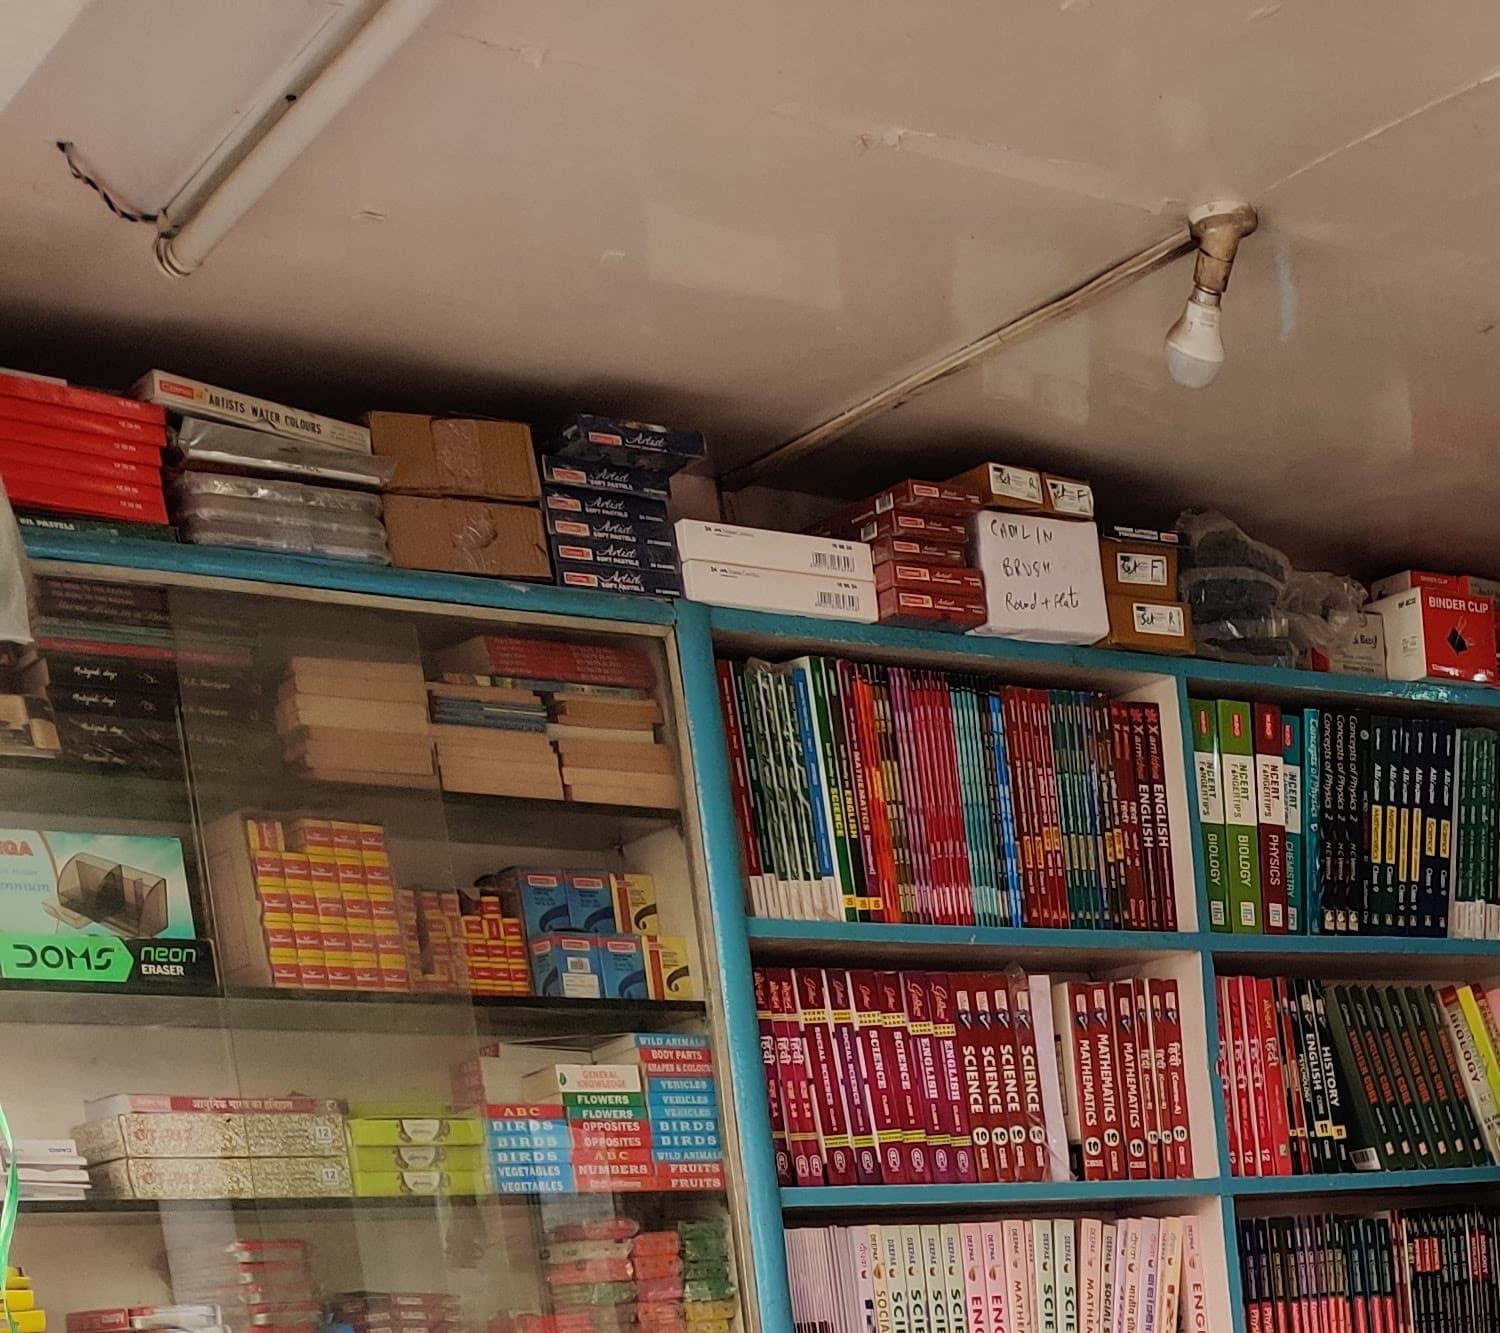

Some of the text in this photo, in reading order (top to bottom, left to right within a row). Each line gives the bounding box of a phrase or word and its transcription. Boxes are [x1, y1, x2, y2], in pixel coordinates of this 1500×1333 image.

[209, 394, 321, 435] ARTISTS WATER COLOURS
[625, 432, 665, 447] Artist
[1428, 596, 1489, 615] BINDER CLIP
[1206, 761, 1217, 799] NCERT
[1238, 761, 1249, 800] NCERT
[1269, 763, 1279, 801] NCERT
[1138, 784, 1153, 848] ENGLISH
[1153, 783, 1169, 847] ENGLISH
[1208, 834, 1222, 887] BIOLOGY
[1238, 835, 1252, 888] BIOLOGY
[1269, 834, 1281, 886] PHYSICS
[1285, 840, 1295, 898] CHEMISTRY
[12, 944, 115, 971] DOMS
[140, 947, 198, 964] neon
[141, 965, 184, 976] ERASER
[639, 1037, 706, 1047] WILD ANIMALS
[1451, 1013, 1480, 1083] BIOLOGY
[652, 1050, 702, 1061] BODY PARTS
[1306, 1033, 1321, 1090] ENGLISH
[583, 1070, 619, 1079] GENERAL
[963, 1046, 983, 1114] SCIENCE
[982, 1046, 1002, 1114] SCIENCE
[1098, 1034, 1116, 1123] MATHEMATICS
[1322, 1045, 1340, 1107] HISTORY
[577, 1079, 626, 1088] KNOWLEDGE
[661, 1080, 706, 1089] VEHICLES
[1080, 1040, 1097, 1126] MATHEMATICS
[1123, 1043, 1140, 1128] MATHEMATICS
[577, 1095, 629, 1104] FLOWERS
[662, 1095, 709, 1104] VEHICLES
[582, 1109, 633, 1119] FLOWERS
[665, 1109, 711, 1117] VEHICLES
[318, 1128, 329, 1137] 12
[583, 1122, 640, 1131] OPPOSITES
[660, 1122, 715, 1131] BIRDS
[975, 1129, 987, 1141] 10
[995, 1130, 1006, 1142] 10
[1012, 1128, 1023, 1140] 10
[585, 1137, 641, 1147] OPPOSITES
[662, 1136, 716, 1145] BIRDS
[500, 1151, 558, 1162] BIRDS
[657, 1151, 679, 1160] WILD
[325, 1170, 336, 1179] 12
[500, 1166, 561, 1176] VEGETABLES
[579, 1165, 648, 1175] NUMBERS
[671, 1164, 720, 1173] FRUITS
[502, 1181, 564, 1192] VEGETABLES
[671, 1178, 721, 1188] FRUITS
[1104, 1283, 1112, 1322] SOCIAL
